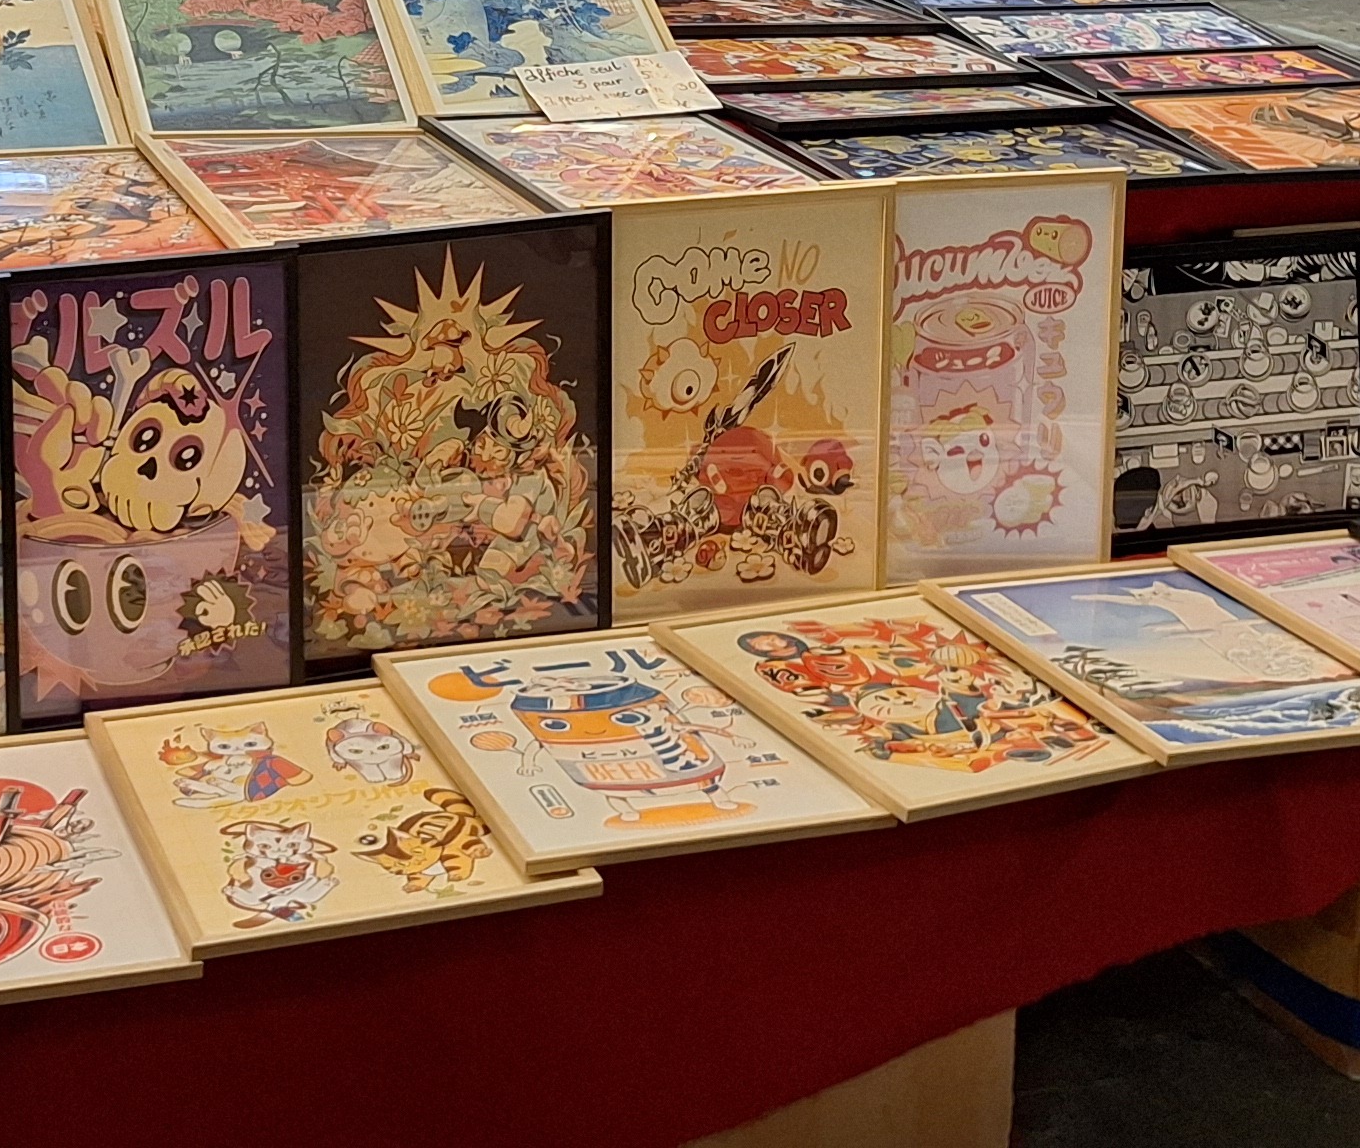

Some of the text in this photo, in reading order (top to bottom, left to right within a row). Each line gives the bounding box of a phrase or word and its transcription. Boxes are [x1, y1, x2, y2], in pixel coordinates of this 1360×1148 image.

[778, 239, 821, 289] NO
[703, 287, 853, 345] CLOSER
[1030, 287, 1069, 308] JUICE
[458, 648, 668, 689] ビール
[584, 760, 662, 782] BEER
